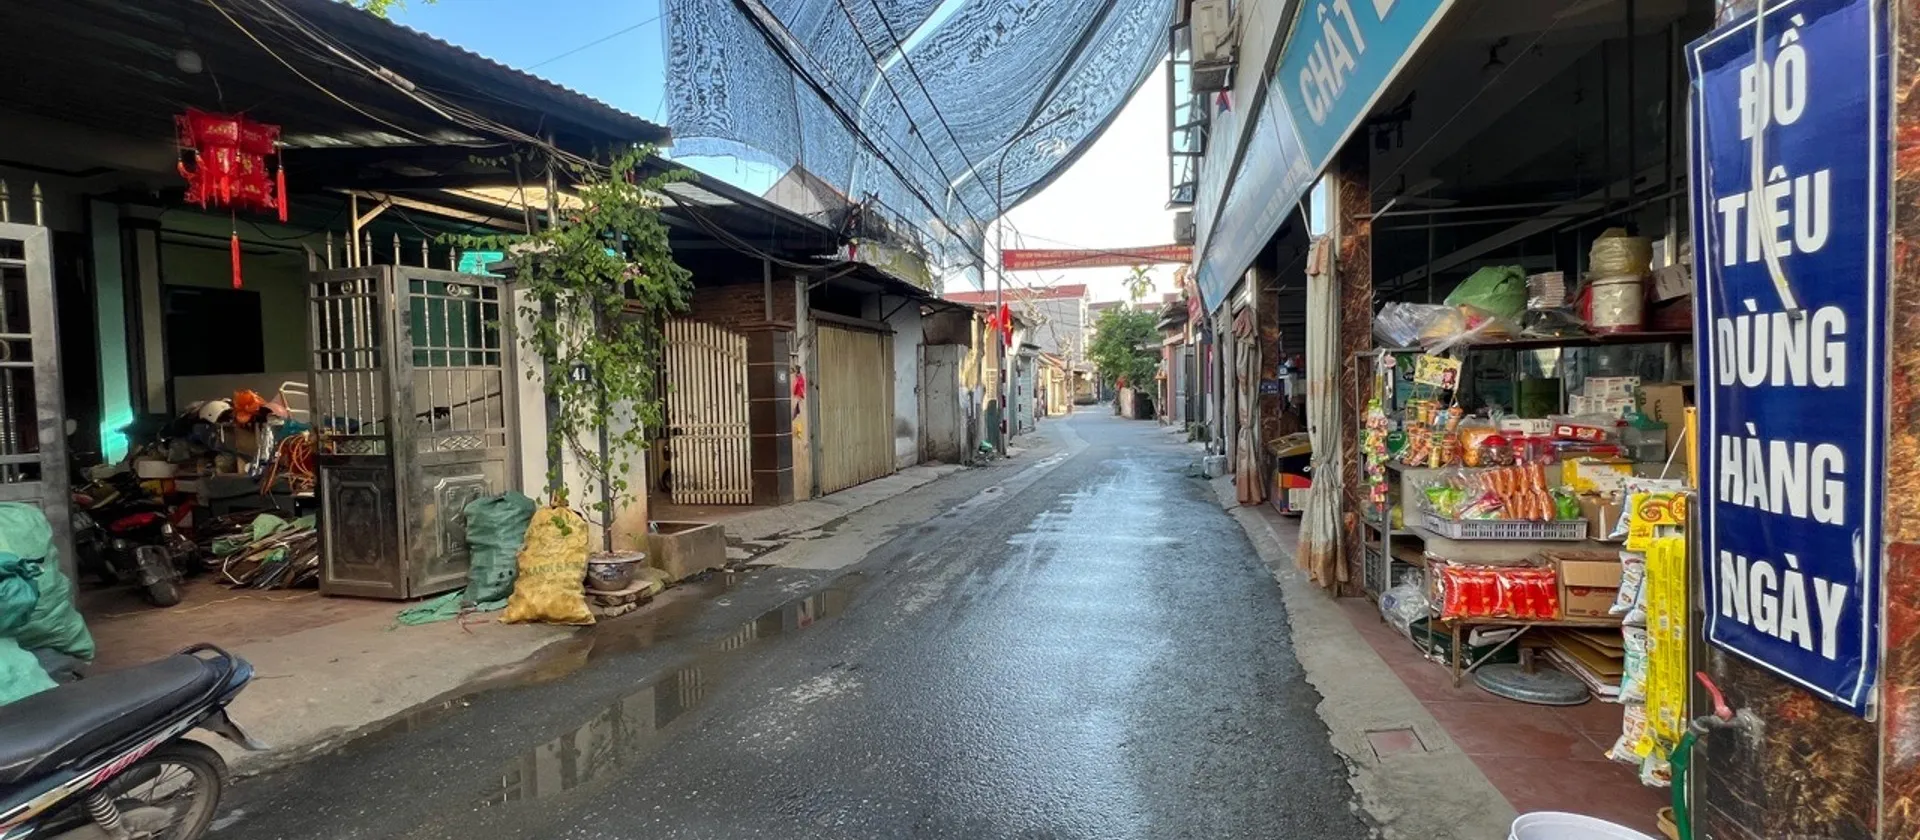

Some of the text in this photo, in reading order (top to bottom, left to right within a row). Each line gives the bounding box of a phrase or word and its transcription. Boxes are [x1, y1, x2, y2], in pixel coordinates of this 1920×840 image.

[1739, 14, 1806, 140] ĐỒ
[1718, 165, 1830, 266] TIÊU
[573, 368, 587, 380] 41
[1717, 299, 1846, 388] DÙNG
[1720, 423, 1845, 526] HÀNG
[1720, 552, 1847, 660] NGÀY
